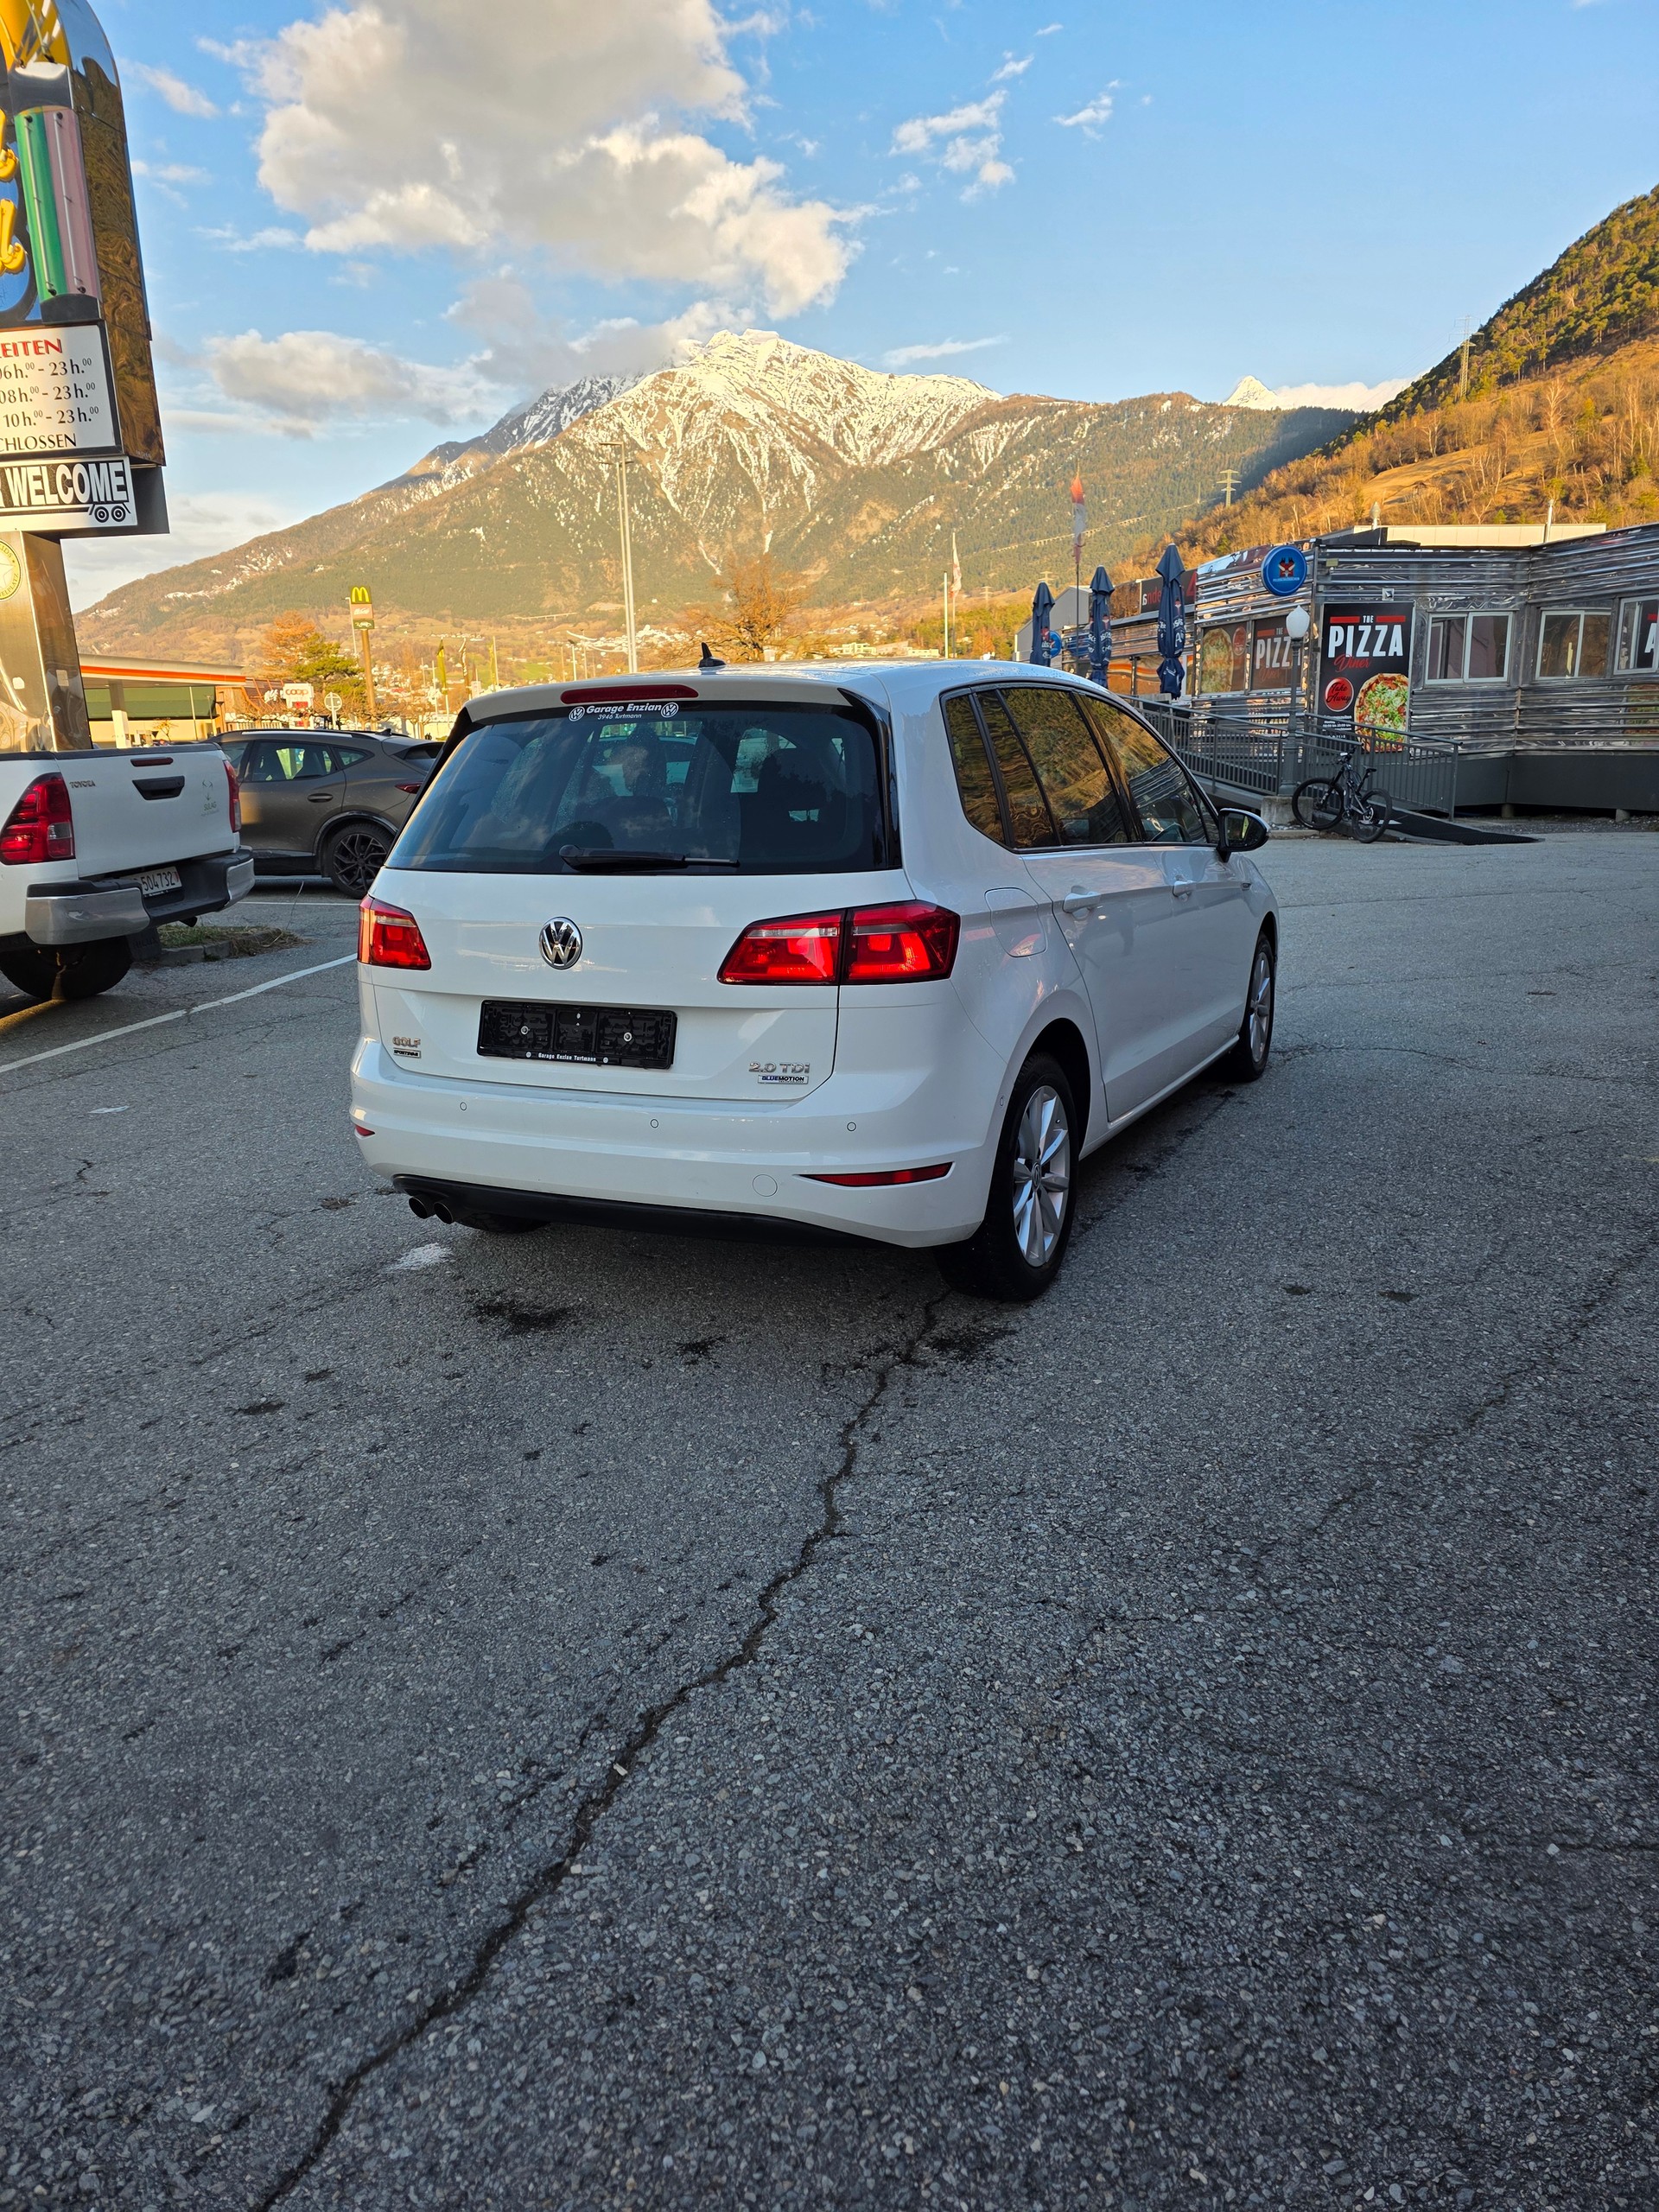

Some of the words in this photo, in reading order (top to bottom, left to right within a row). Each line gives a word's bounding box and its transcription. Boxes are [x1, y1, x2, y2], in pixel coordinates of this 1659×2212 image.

[0, 338, 63, 359] EITEN
[4, 461, 128, 507] WELCOME
[0, 573, 19, 598] ELPLATZ
[1363, 615, 1374, 624] THE
[1327, 624, 1404, 658] PIZZA
[1333, 653, 1370, 673] Diner
[586, 704, 625, 715] Garage
[626, 702, 662, 712] Enzian
[69, 779, 96, 789] TOYOTA
[140, 871, 175, 892] 504732
[392, 1035, 422, 1048] GOLF
[537, 1052, 555, 1060] Garage
[748, 1061, 777, 1073] 2.0
[779, 1063, 810, 1074] TDI
